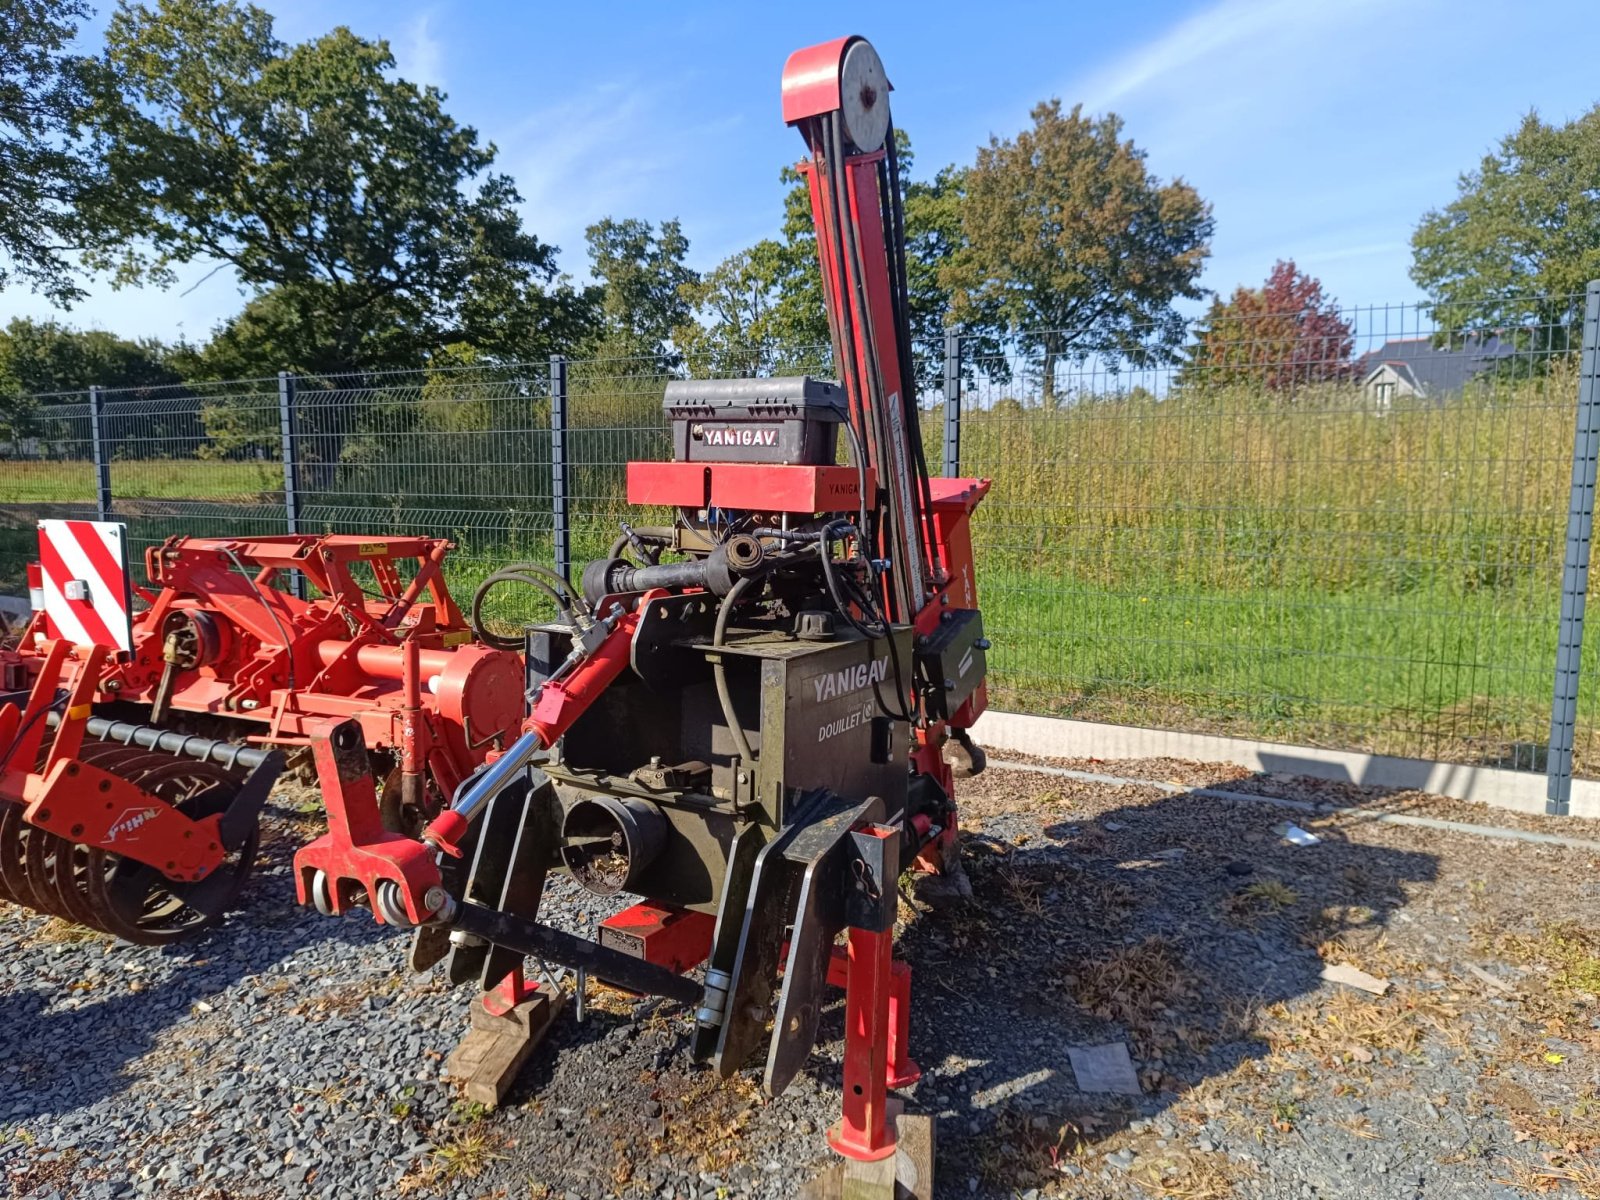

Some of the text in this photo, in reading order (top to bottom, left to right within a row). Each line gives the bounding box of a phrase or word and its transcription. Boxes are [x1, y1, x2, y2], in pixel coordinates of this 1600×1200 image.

[829, 483, 861, 495] YANIGA
[814, 655, 888, 702] YANIGAV
[818, 711, 862, 742] DOUILLET
